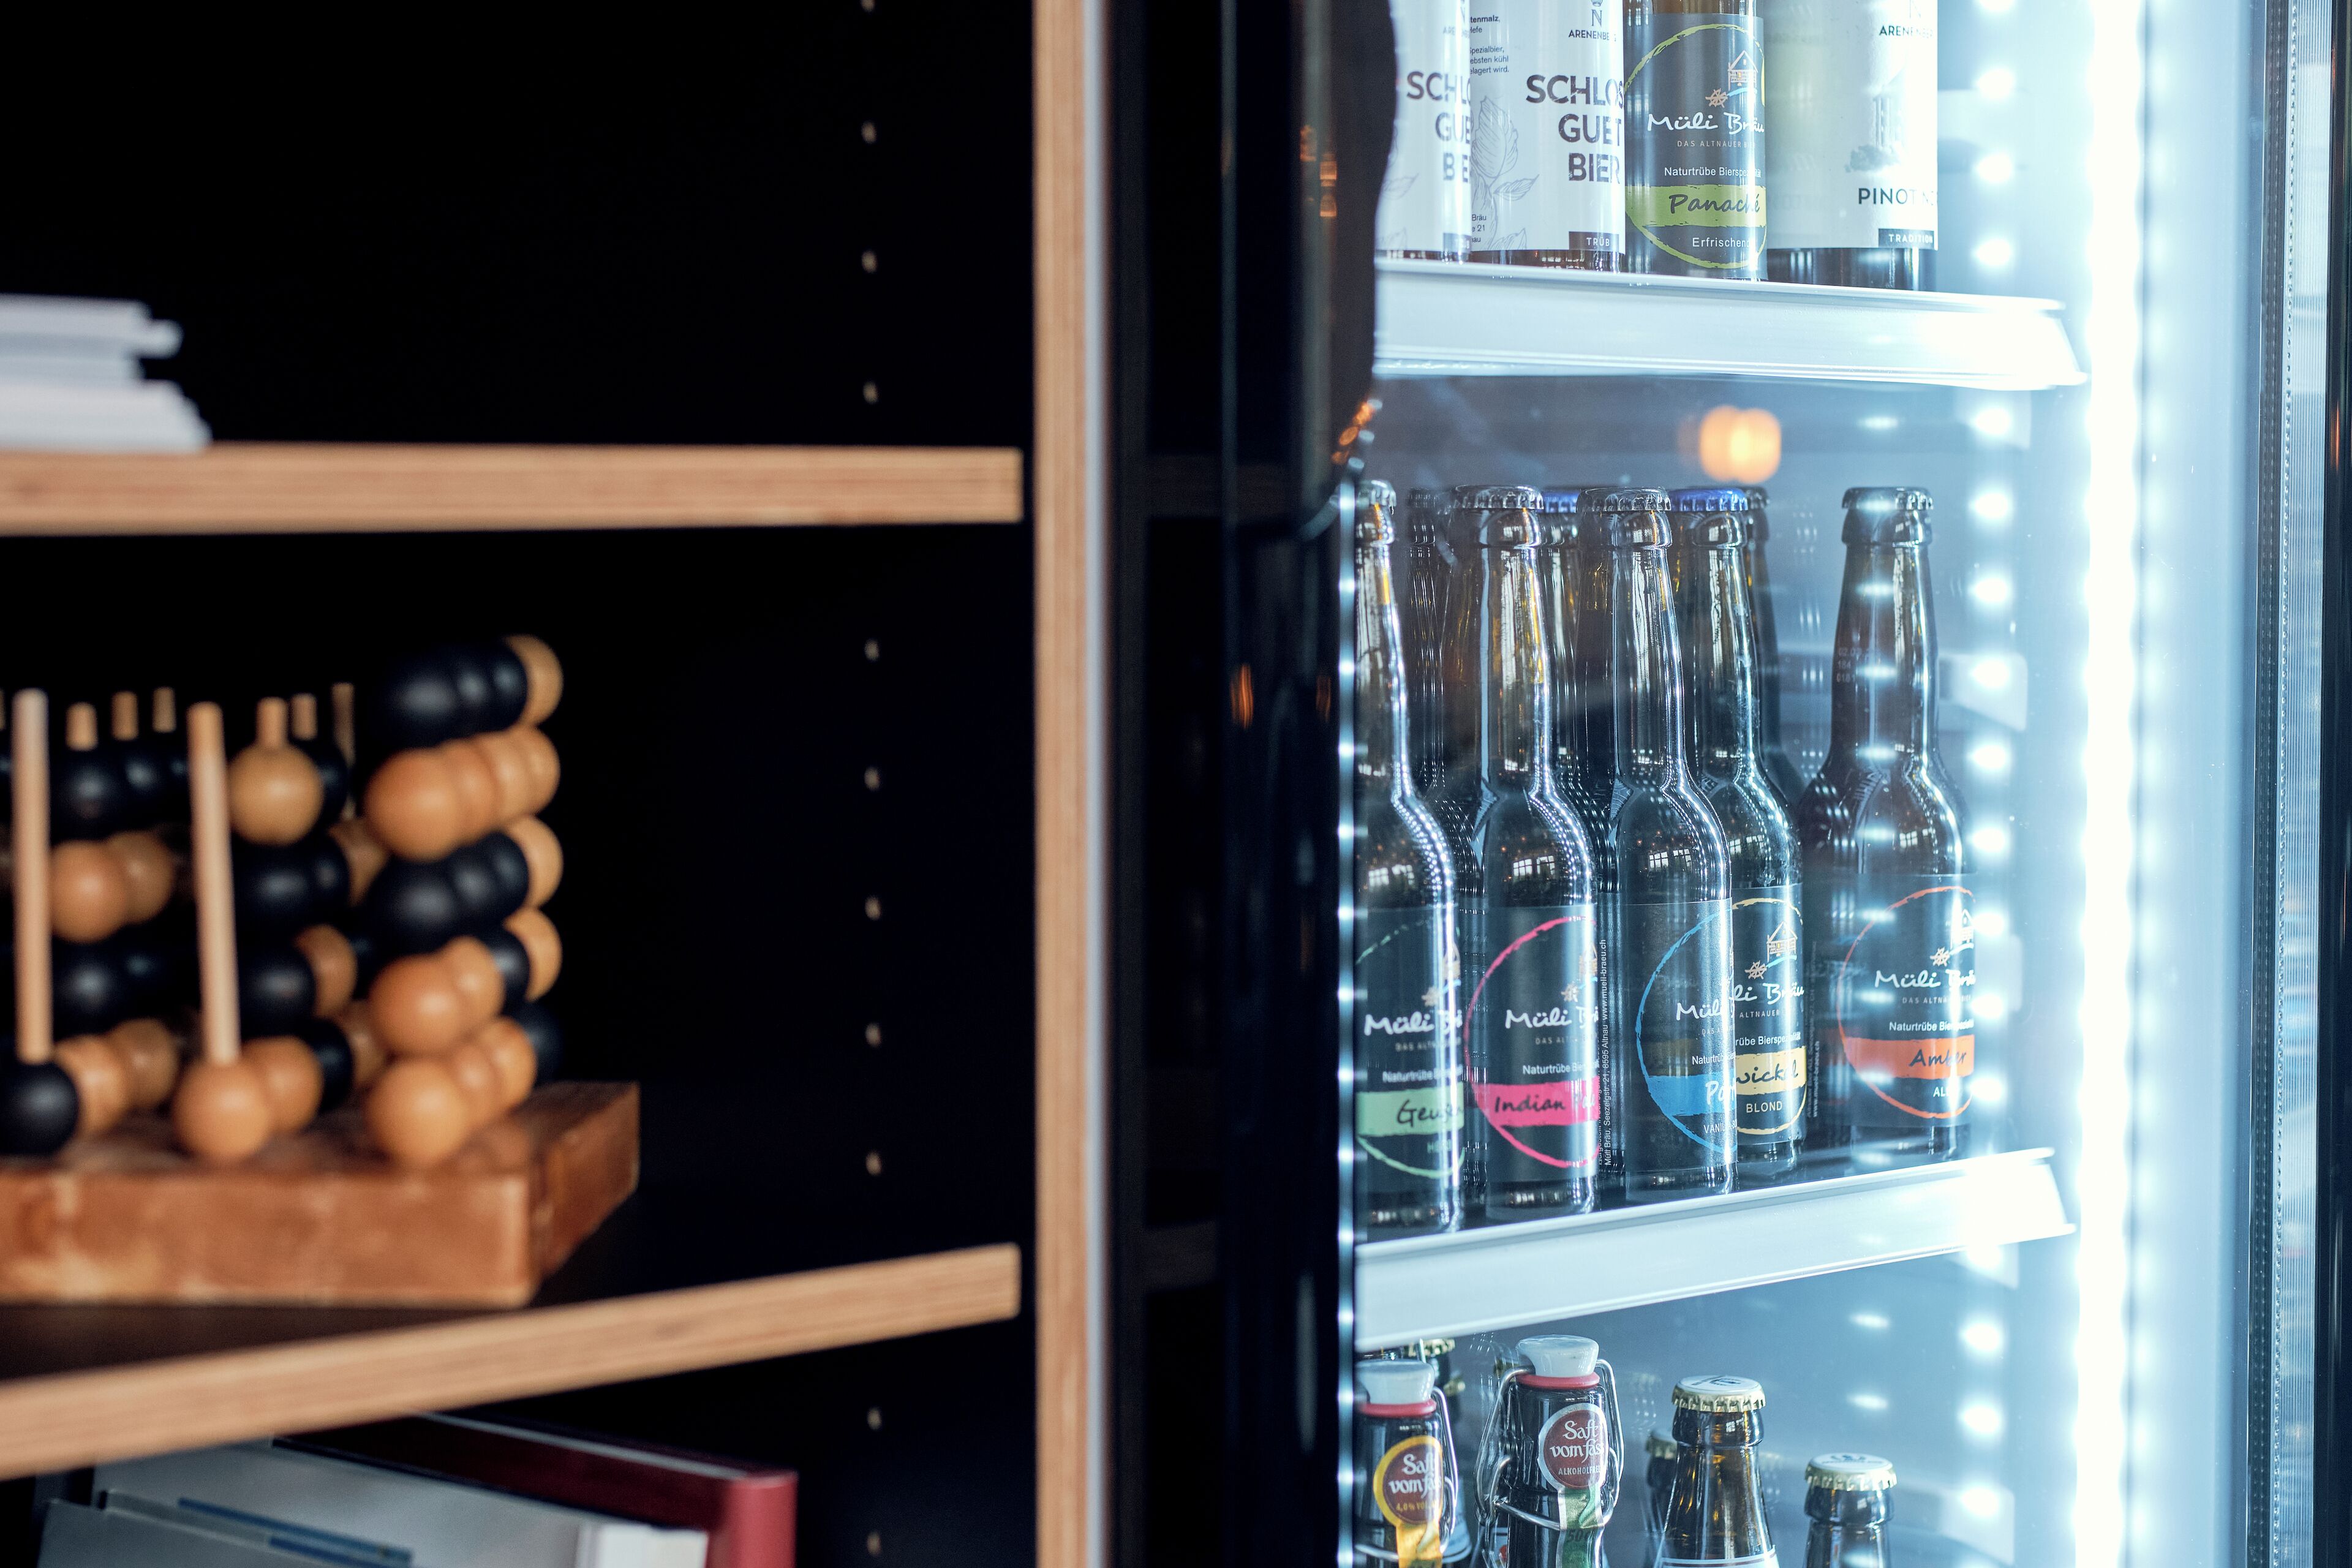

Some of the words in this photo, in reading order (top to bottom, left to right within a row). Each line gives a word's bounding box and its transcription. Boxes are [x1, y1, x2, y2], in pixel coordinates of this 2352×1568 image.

[1569, 29, 1616, 42] ARENENBE
[1558, 113, 1622, 146] GUET
[1647, 112, 1718, 132] Müli
[1724, 111, 1764, 135] Bräu
[1569, 153, 1620, 184] BIER
[1664, 167, 1716, 176] Naturtrübe
[1858, 187, 1917, 205] PINOT
[1586, 236, 1610, 247] TRÜB
[1874, 970, 1941, 988] Müli
[1762, 981, 1804, 1005] Bräu
[1923, 996, 1954, 1005] ALTNA
[1505, 1007, 1572, 1029] Müli
[1676, 999, 1724, 1021] Mül
[1364, 1011, 1435, 1036] Müli
[1889, 1021, 1937, 1031] Naturtrübe
[1692, 1051, 1727, 1065] Naturtrüb
[1908, 1048, 1967, 1067] Amber
[1522, 1063, 1571, 1075] Naturtrübe
[1736, 1059, 1798, 1084] wickl
[1933, 1086, 1951, 1098] AL
[1494, 1094, 1566, 1113] Indian
[1746, 1101, 1783, 1114] BLOND
[1562, 1419, 1599, 1441] Saft
